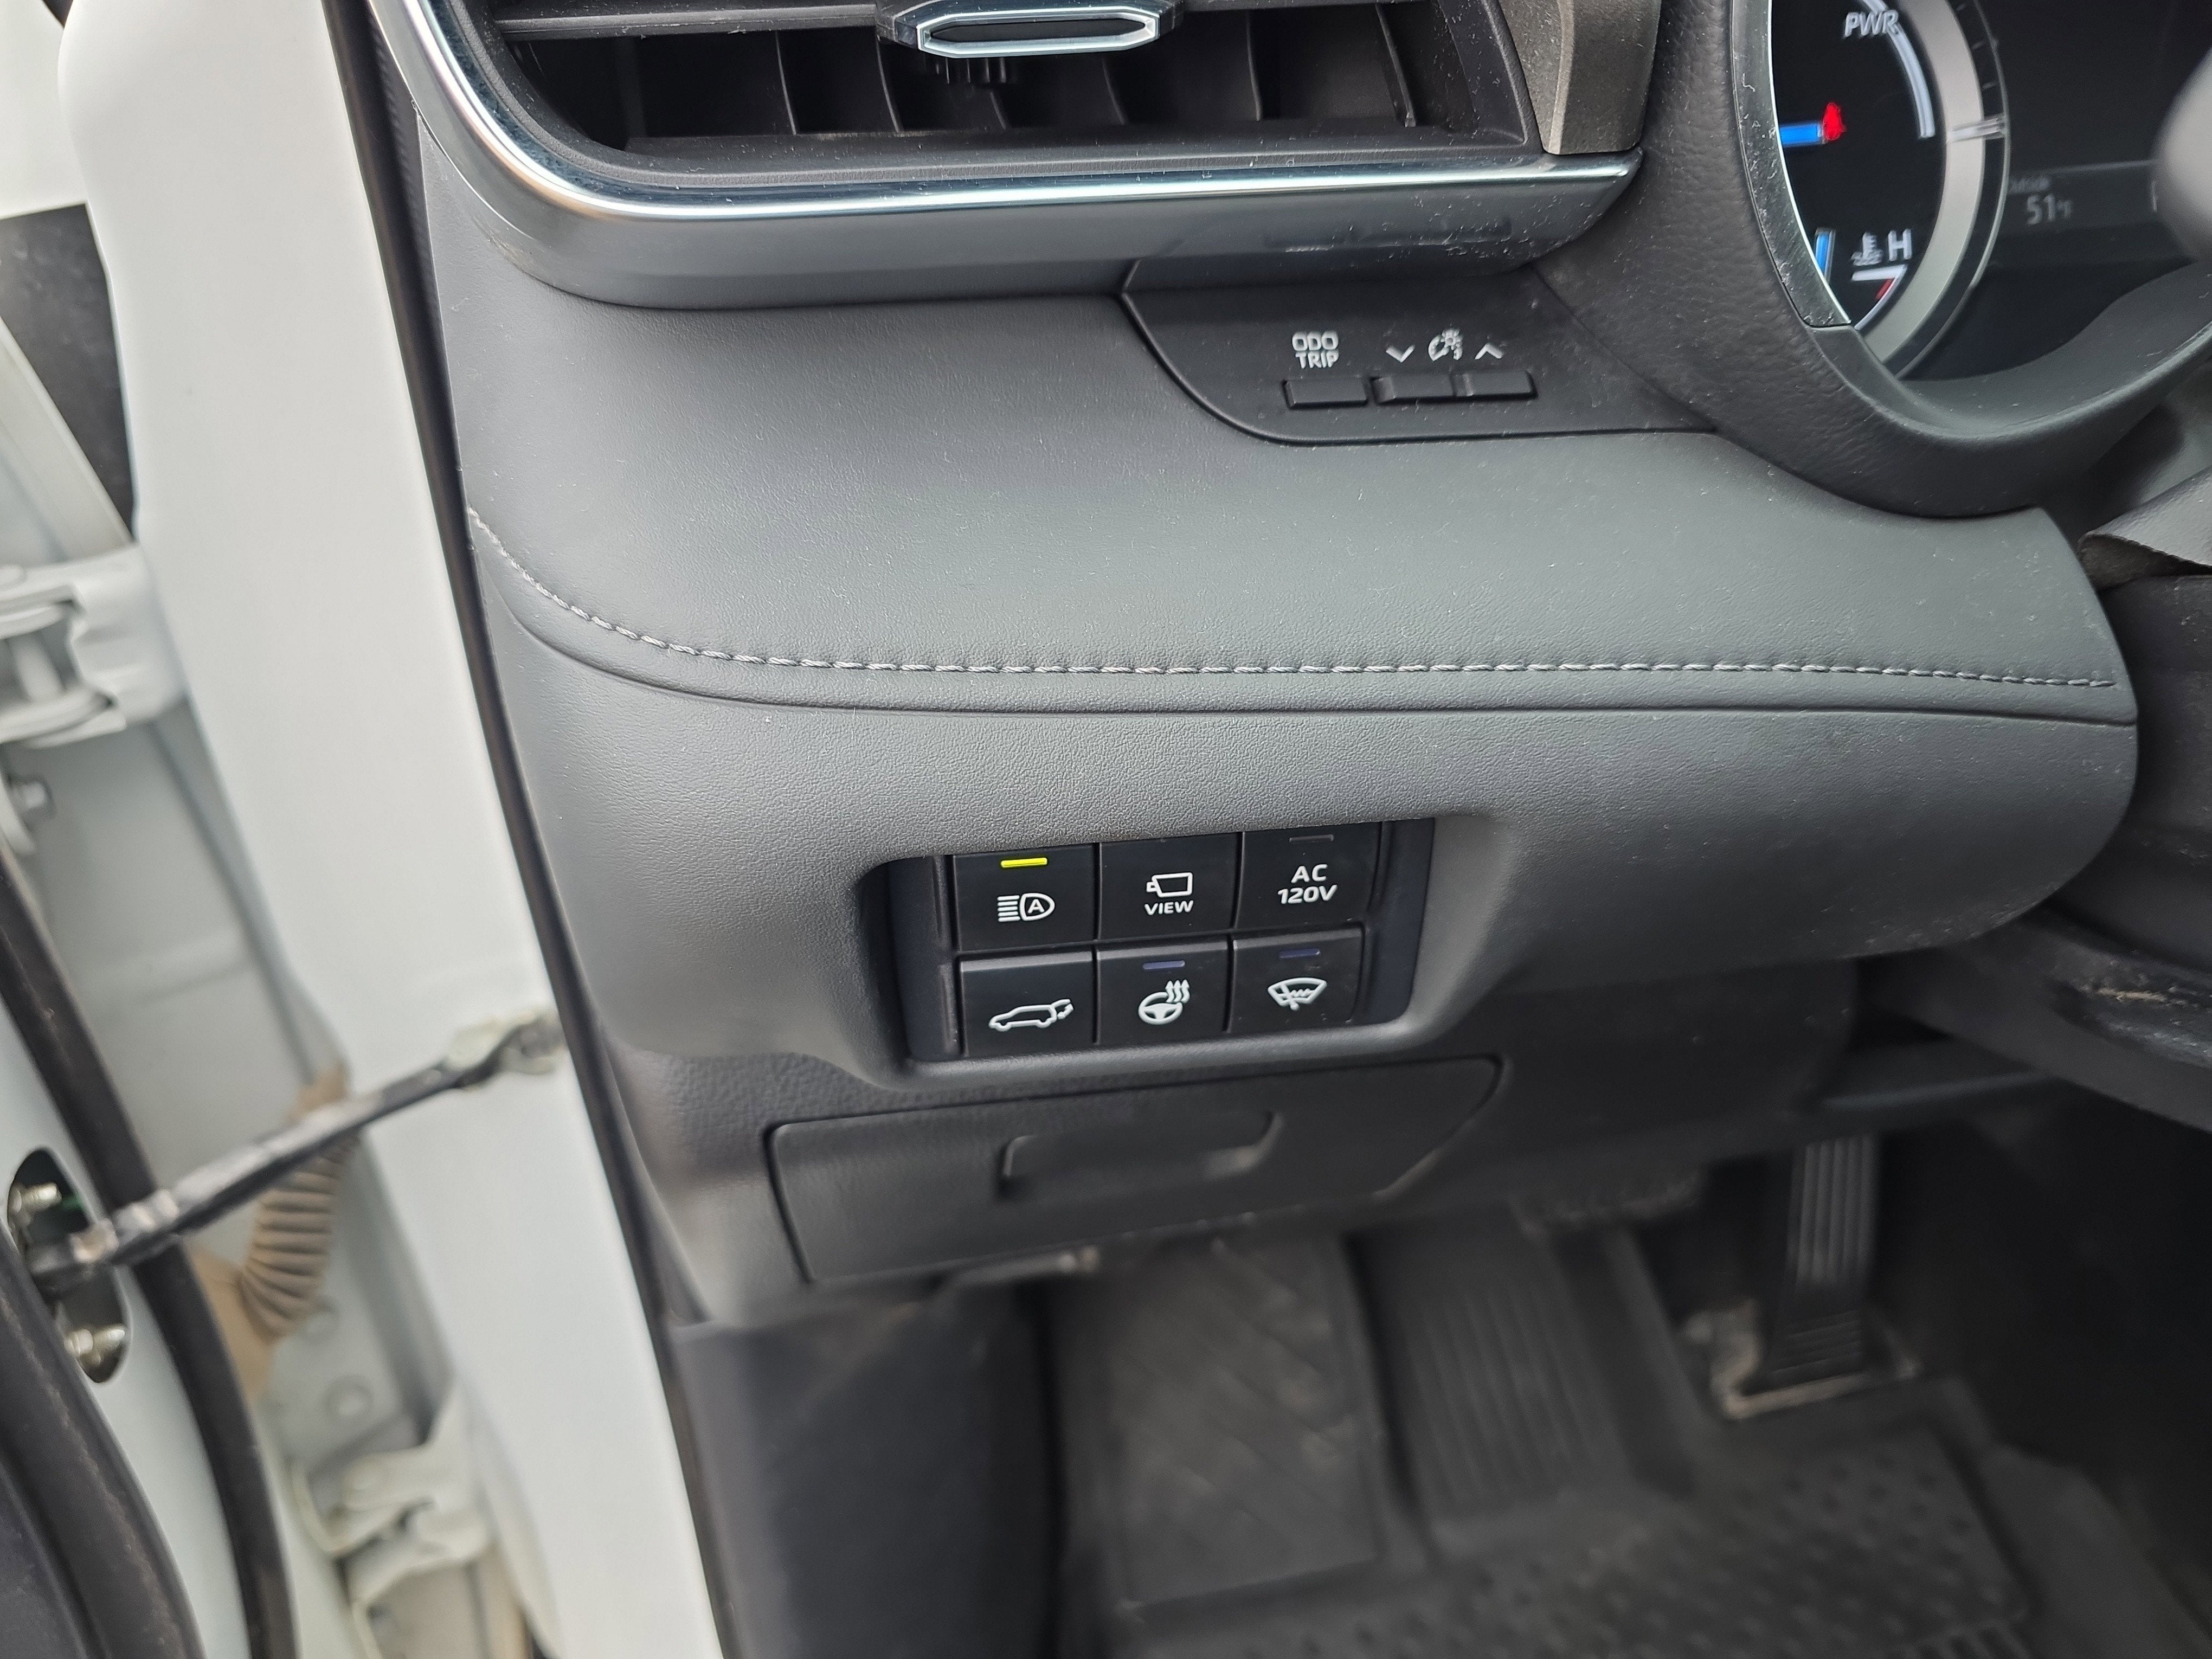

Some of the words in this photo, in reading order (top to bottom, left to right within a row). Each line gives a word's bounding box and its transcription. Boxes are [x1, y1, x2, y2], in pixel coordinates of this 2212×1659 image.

[1844, 10, 1899, 37] PWR
[1888, 228, 1912, 261] H
[1292, 331, 1339, 351] ODO
[1295, 350, 1339, 369] TRIP
[1291, 864, 1328, 883] AC
[1277, 884, 1338, 904] 120V
[1144, 900, 1193, 916] VIEW
